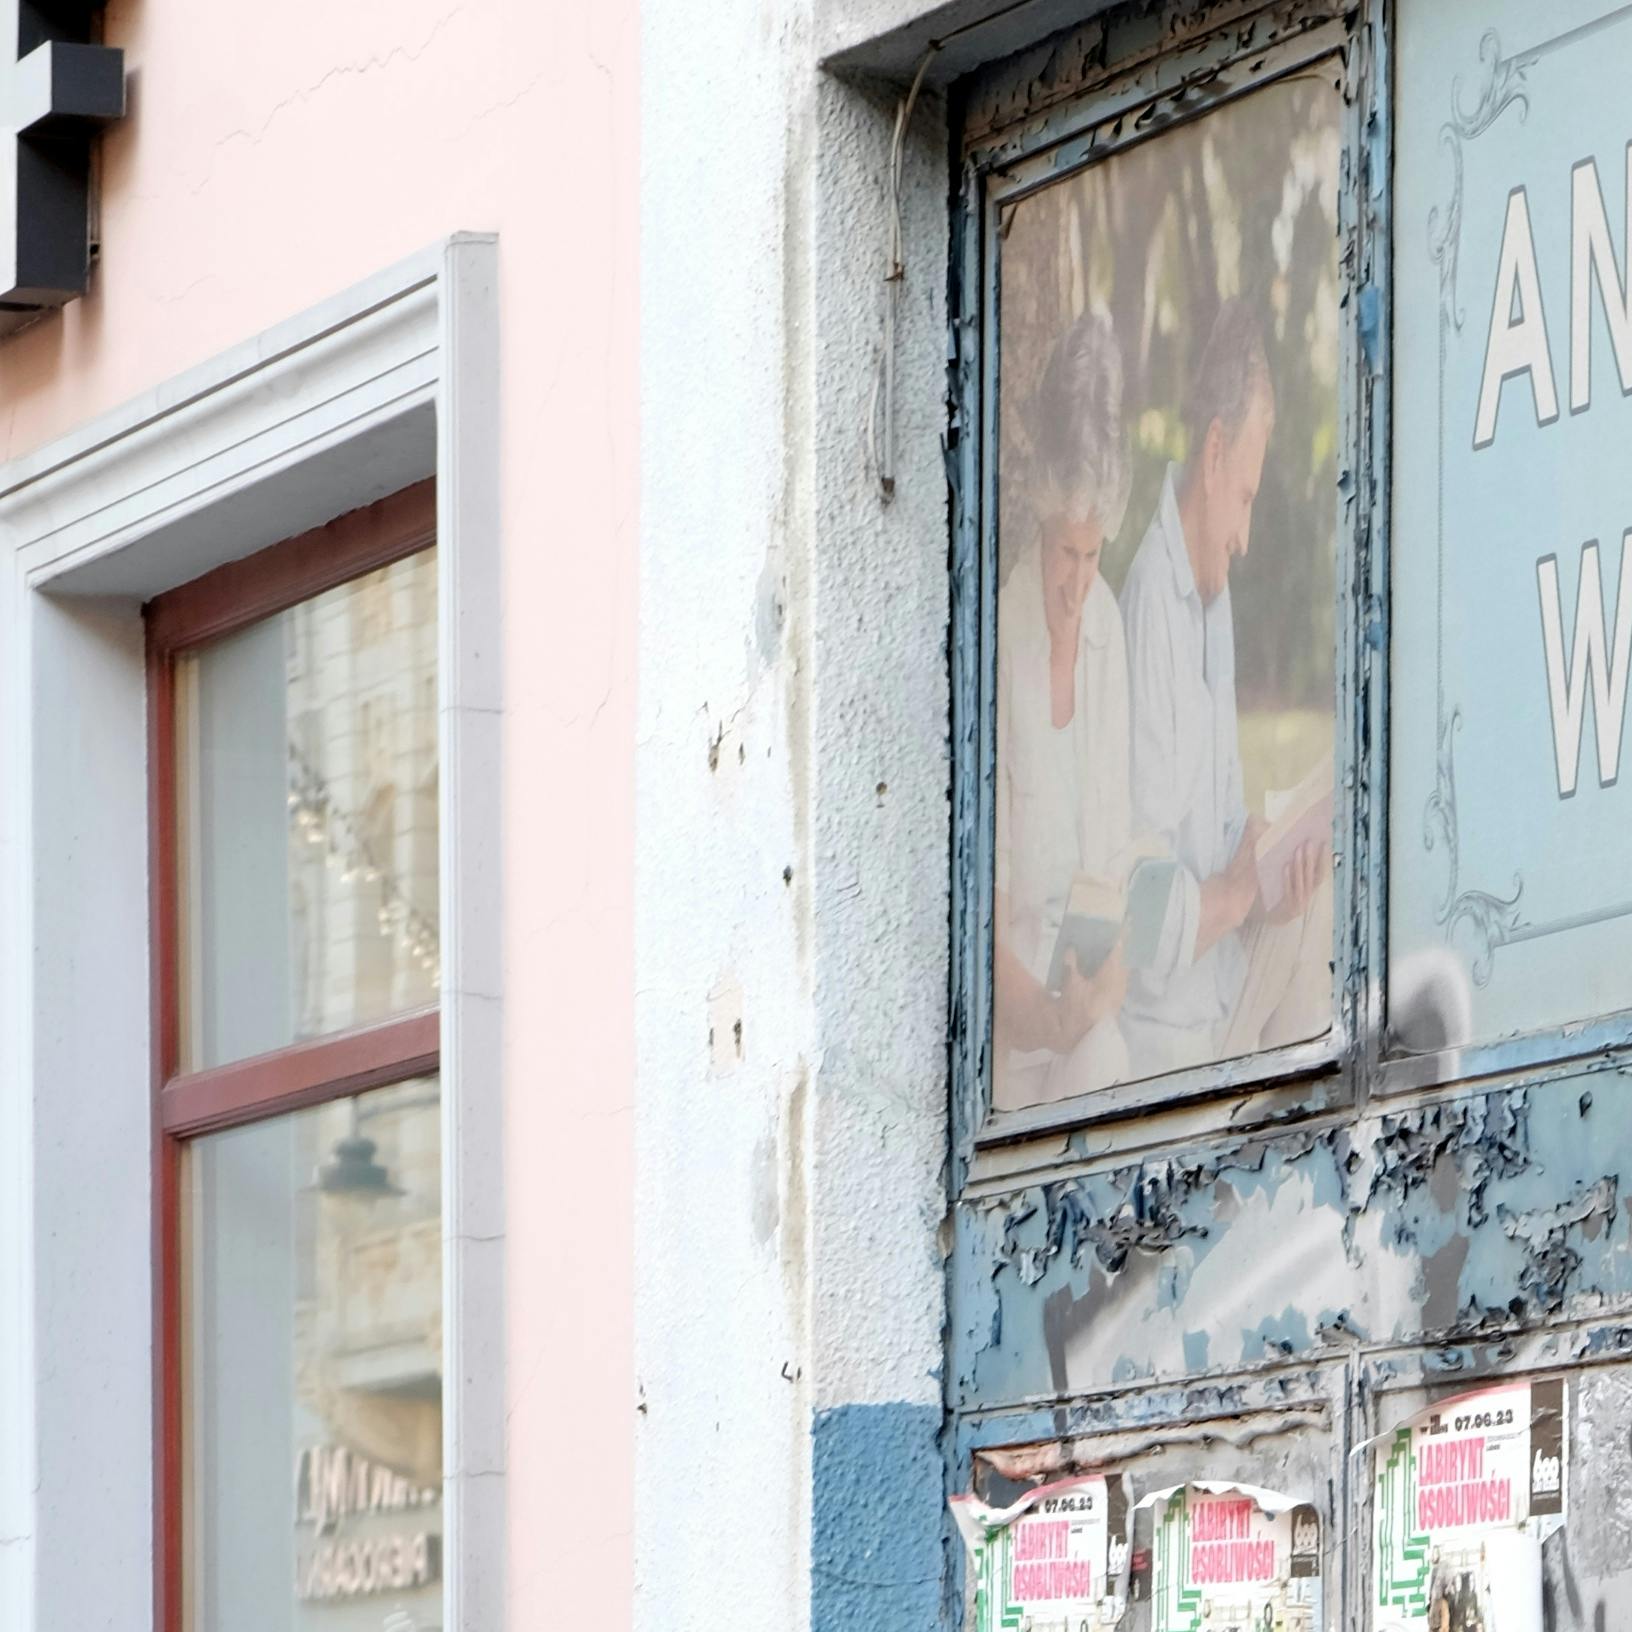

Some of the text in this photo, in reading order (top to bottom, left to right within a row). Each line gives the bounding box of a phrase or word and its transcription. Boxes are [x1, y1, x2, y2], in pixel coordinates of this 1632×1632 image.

[1454, 1409, 1514, 1432] 07.06.23
[1419, 1436, 1485, 1487] LABIRYNT
[1418, 1469, 1511, 1532] OSOBLIWOŚCI
